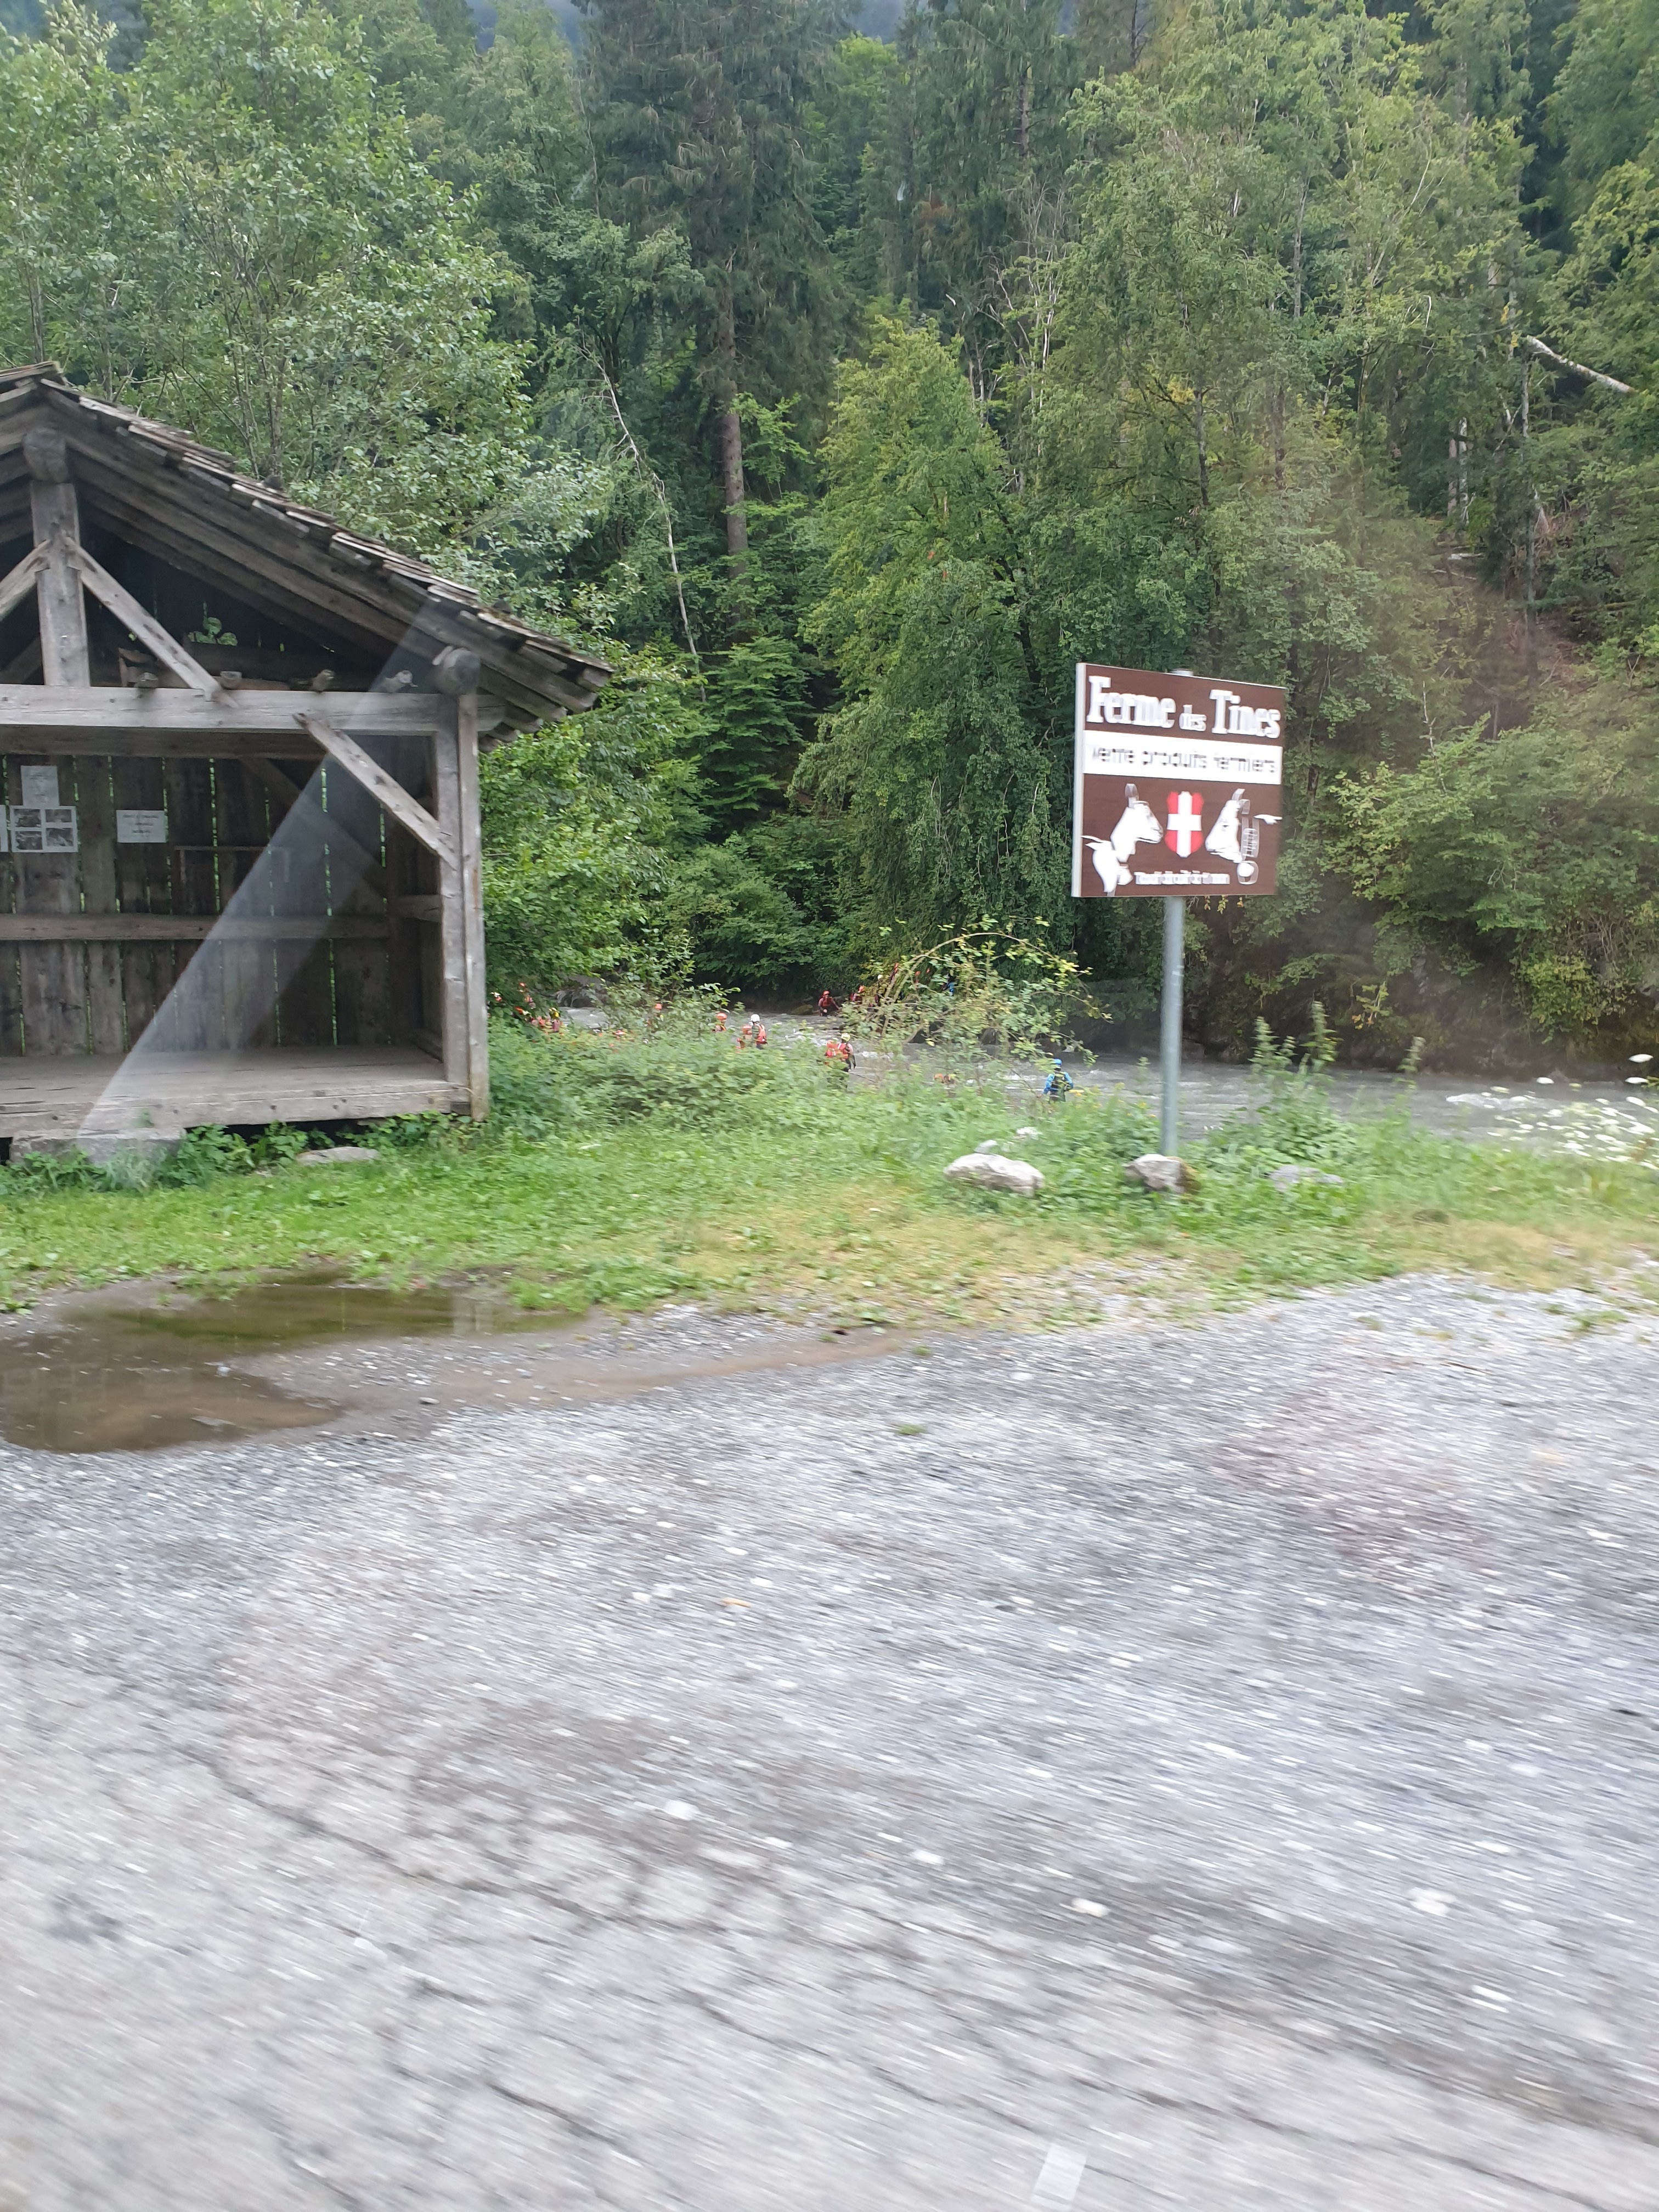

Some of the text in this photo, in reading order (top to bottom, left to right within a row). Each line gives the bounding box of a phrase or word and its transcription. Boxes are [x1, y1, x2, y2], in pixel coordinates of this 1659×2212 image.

[1086, 675, 1281, 738] Ferme des Tines
